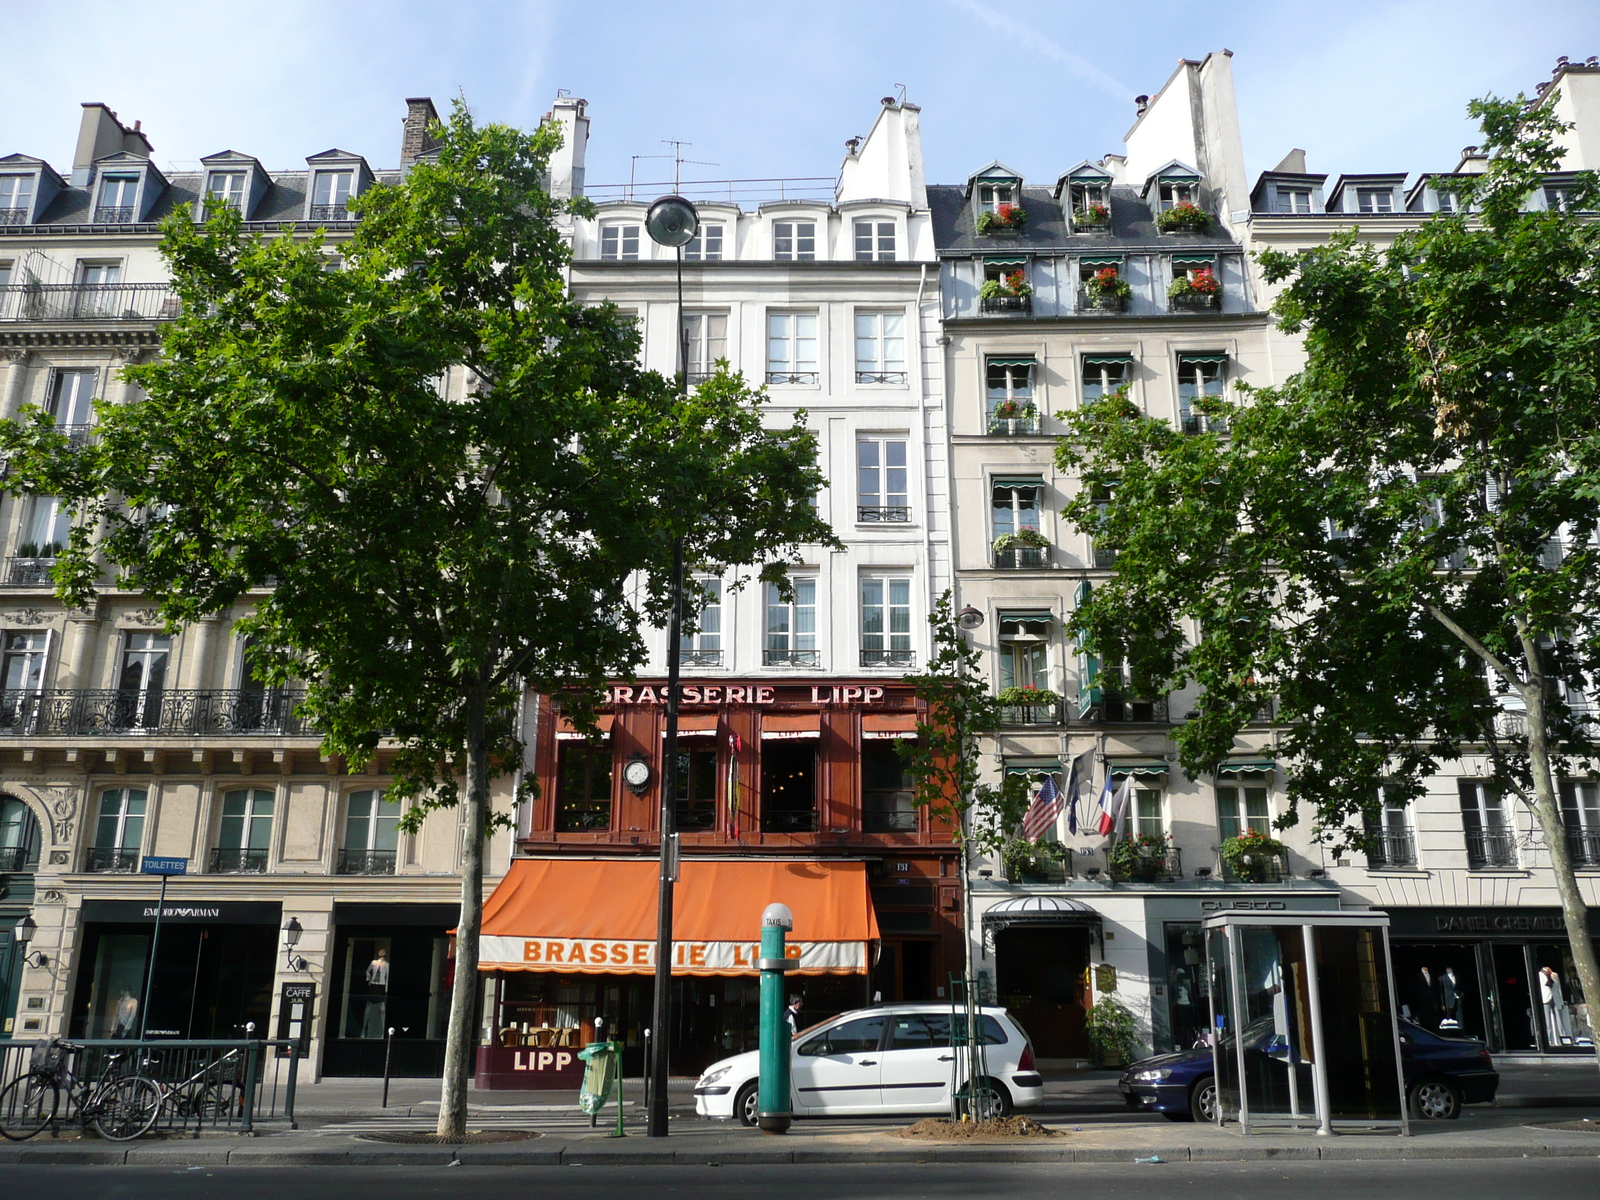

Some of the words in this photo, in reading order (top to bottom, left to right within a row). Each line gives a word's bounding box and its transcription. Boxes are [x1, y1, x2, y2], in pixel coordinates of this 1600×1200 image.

[811, 686, 884, 704] LIPP
[144, 860, 185, 870] TOILETTES
[897, 862, 908, 872] 151
[143, 907, 177, 917] EMORIO
[189, 907, 219, 917] ARMANI
[766, 918, 782, 927] TAXIS
[1436, 916, 1488, 931] DANIEL
[524, 941, 707, 966] BRASSEIE
[733, 945, 802, 965] LIP
[513, 1051, 572, 1071] LIPP
